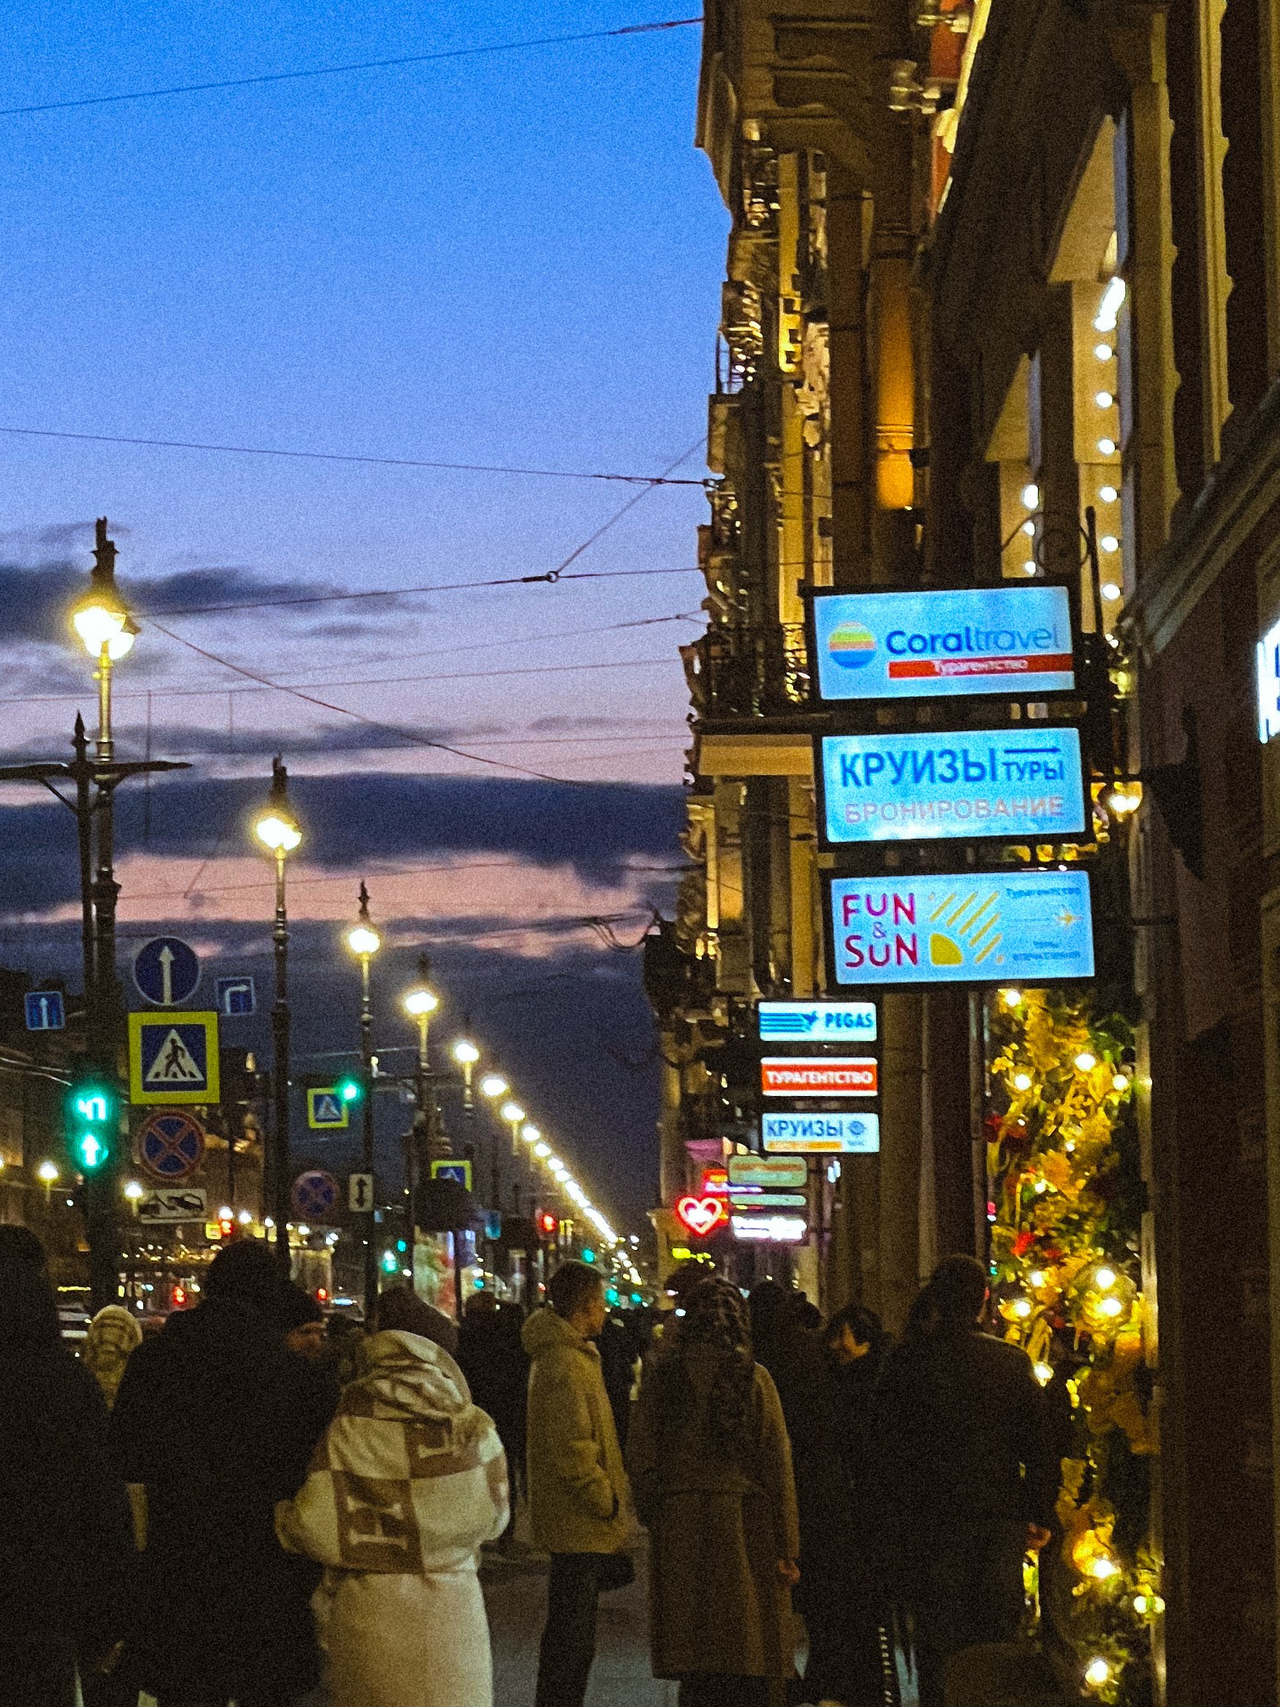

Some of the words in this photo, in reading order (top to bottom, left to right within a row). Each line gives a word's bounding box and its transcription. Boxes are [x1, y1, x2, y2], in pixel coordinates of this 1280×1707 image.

[840, 747, 998, 787] КРУИЗЫ
[1002, 760, 1064, 782] ТУРЫ
[845, 795, 1065, 825] БРОНИРОВАНИЕ
[842, 892, 916, 927] FUN
[872, 921, 888, 940] &
[845, 932, 918, 968] SUN
[824, 1012, 874, 1029] PEGAS
[767, 1119, 844, 1137] КРУИЗЫ
